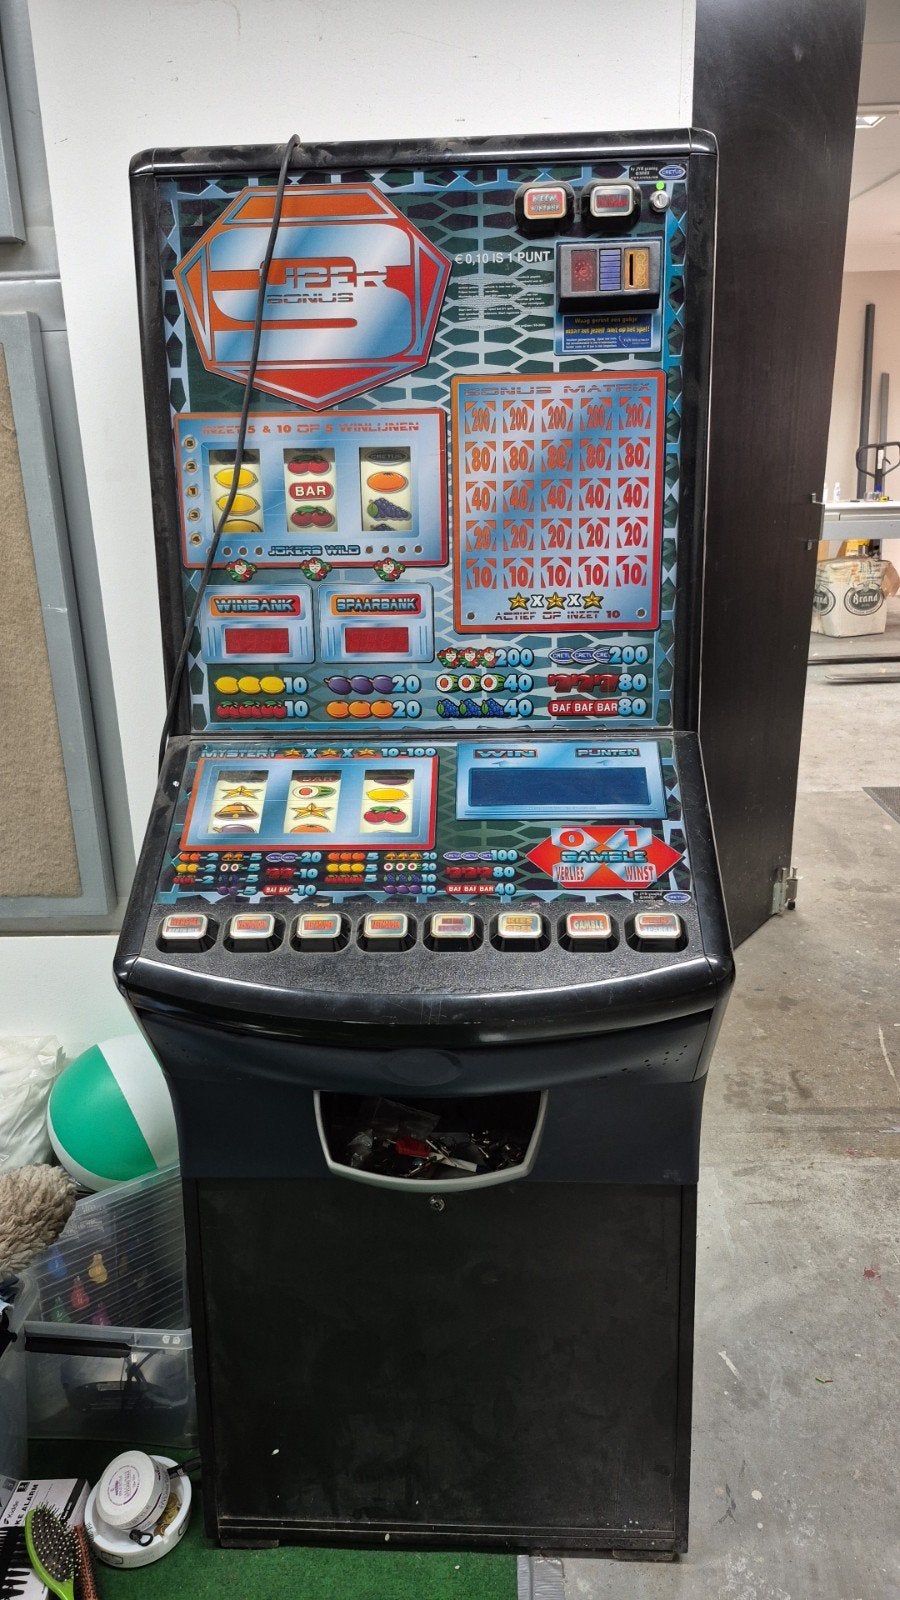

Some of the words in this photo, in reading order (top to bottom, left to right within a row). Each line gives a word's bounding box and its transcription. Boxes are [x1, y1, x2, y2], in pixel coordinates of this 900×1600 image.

[465, 253, 489, 266] 0,10
[492, 252, 504, 263] IS
[508, 252, 513, 263] 1
[517, 251, 551, 263] PUNT
[266, 292, 354, 304] BONUS
[464, 386, 552, 397] BONUS
[563, 383, 651, 394] MATRIX
[471, 407, 491, 432] 200
[509, 406, 529, 431] 200
[547, 405, 567, 430] 200
[586, 405, 605, 429] 200
[625, 403, 644, 428] 200
[247, 425, 256, 434] 5
[262, 425, 271, 434] &
[276, 424, 292, 433] 10
[471, 446, 491, 471] 80
[509, 446, 529, 471] 80
[547, 445, 567, 470] 80
[586, 444, 605, 469] 80
[624, 443, 644, 468] 80
[294, 485, 327, 497] BAR
[471, 487, 491, 511] 40
[509, 486, 529, 511] 40
[547, 485, 567, 510] 40
[585, 484, 605, 509] 40
[623, 483, 642, 508] 40
[473, 525, 492, 550] 20
[510, 524, 528, 549] 20
[547, 523, 566, 548] 20
[585, 523, 604, 548] 20
[624, 522, 642, 547] 20
[268, 545, 323, 557] JOKERS
[324, 544, 361, 556] WILD
[472, 566, 493, 588] 10
[509, 565, 530, 588] 10
[546, 565, 567, 587] 10
[584, 564, 604, 586] 10
[621, 563, 642, 586] 10
[214, 598, 296, 612] WINBANK
[336, 597, 417, 613] SPAARBANK
[852, 592, 879, 605] Brand
[495, 611, 537, 621] ACTIEF
[542, 611, 562, 620] OP
[567, 610, 600, 620] INZET
[605, 609, 621, 619] 10
[494, 648, 535, 668] 200
[608, 645, 649, 665] 200
[283, 676, 309, 694] 10
[391, 674, 422, 694] 20
[503, 672, 534, 692] 40
[618, 673, 648, 693] 80
[284, 700, 310, 718] 10
[392, 700, 422, 718] 20
[503, 699, 534, 718] 40
[597, 702, 618, 712] BAR
[617, 697, 648, 718] 80
[478, 749, 535, 758] WIN
[577, 748, 638, 757] PUNTEN
[559, 830, 585, 848] 0
[623, 830, 638, 847] 1
[422, 851, 438, 861] 20
[490, 849, 518, 861] 100
[561, 849, 648, 863] GAMBLE
[421, 862, 437, 871] 20
[492, 866, 515, 878] 80
[555, 866, 585, 881] VERLIES
[624, 865, 654, 881] WINST
[421, 873, 437, 883] 10
[420, 885, 436, 894] 10
[494, 882, 516, 895] 40
[573, 920, 604, 931] GAMBLE
[21, 1484, 39, 1512] ALARM
